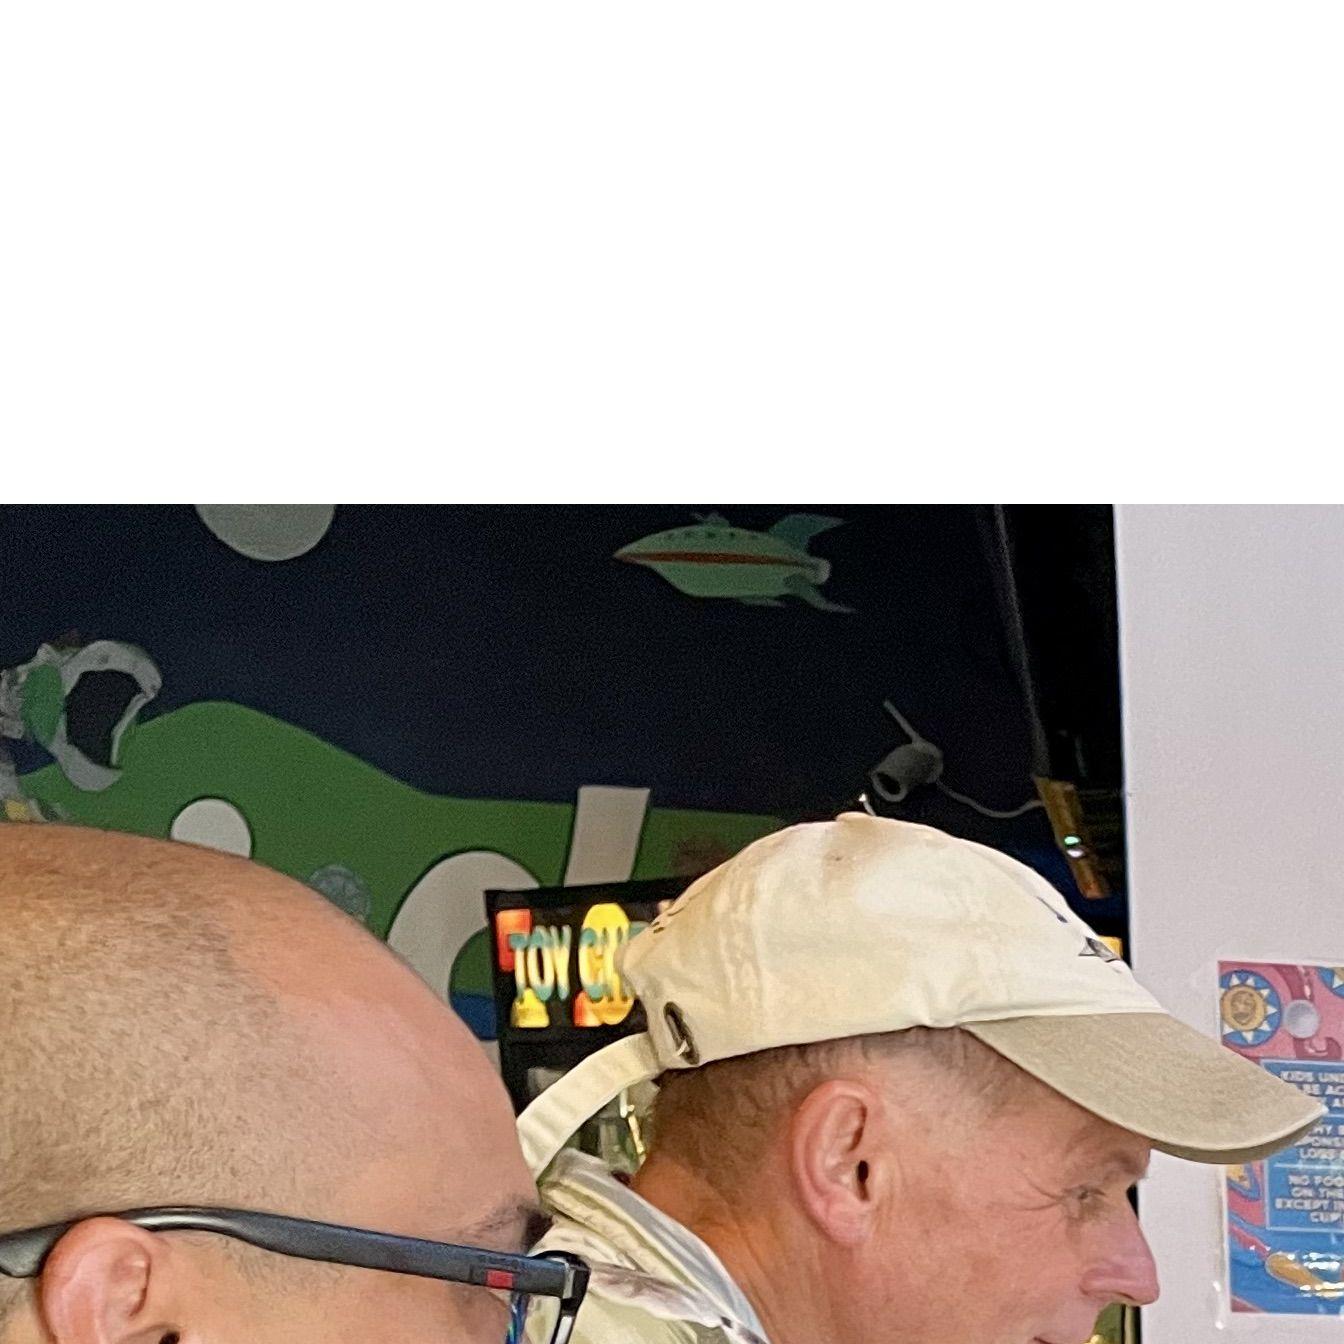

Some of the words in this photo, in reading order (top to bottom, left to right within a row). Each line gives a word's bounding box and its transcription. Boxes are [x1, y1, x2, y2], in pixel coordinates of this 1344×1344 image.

[509, 925, 572, 1001] TOY
[1300, 1148, 1336, 1160] LOSS
[1288, 1175, 1310, 1186] NO
[1290, 1187, 1314, 1198] ON
[1318, 1187, 1344, 1200] THE
[1274, 1197, 1330, 1210] EXCEPT
[1310, 1211, 1342, 1224] CUP
